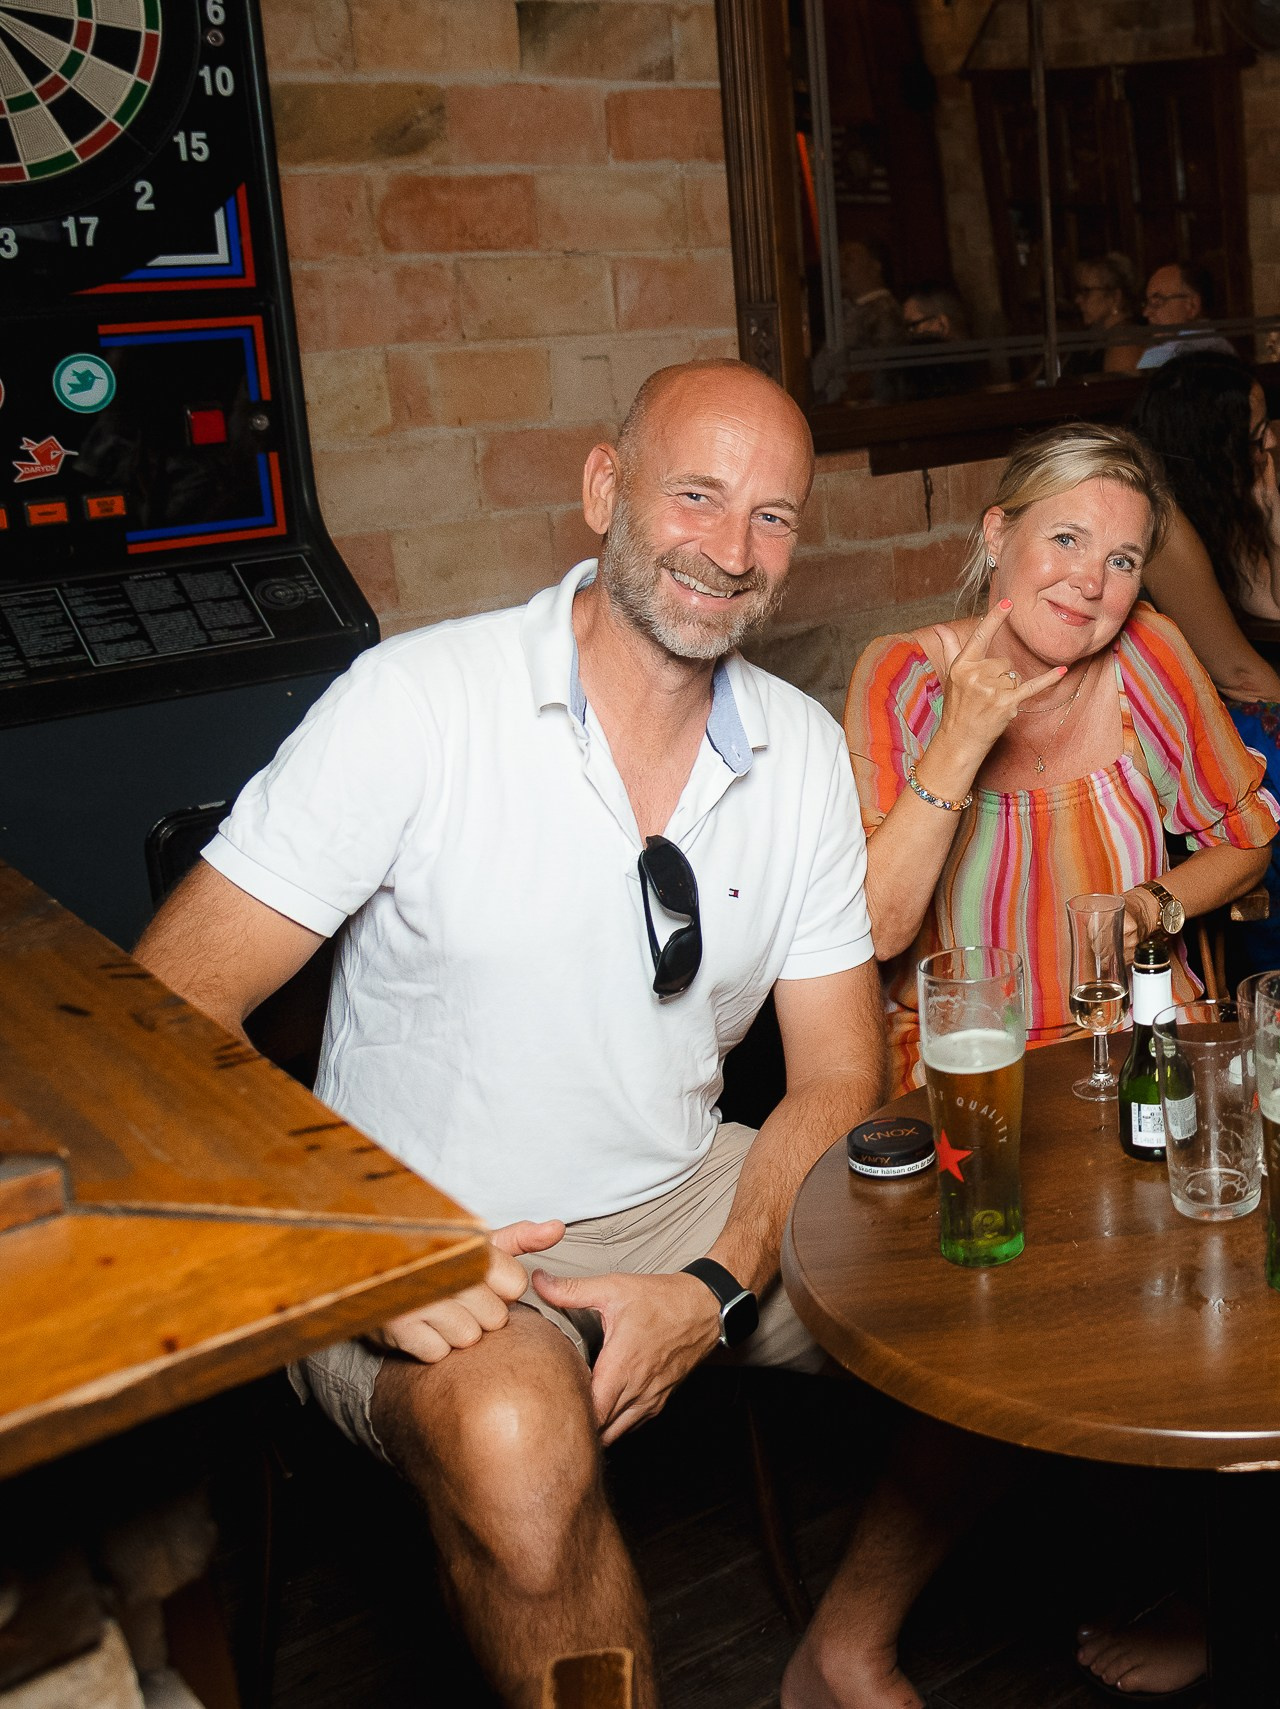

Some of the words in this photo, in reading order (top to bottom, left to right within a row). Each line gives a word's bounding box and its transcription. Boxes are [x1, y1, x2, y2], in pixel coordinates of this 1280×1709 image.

[206, 0, 226, 25] 6
[199, 65, 235, 97] 10
[173, 131, 210, 162] 15
[134, 180, 155, 211] 2
[0, 227, 19, 259] 3
[62, 216, 99, 247] 17
[863, 1127, 919, 1142] KNOX
[956, 1096, 1008, 1143] QUALITY
[858, 1165, 879, 1174] skadar
[907, 1164, 920, 1172] och
